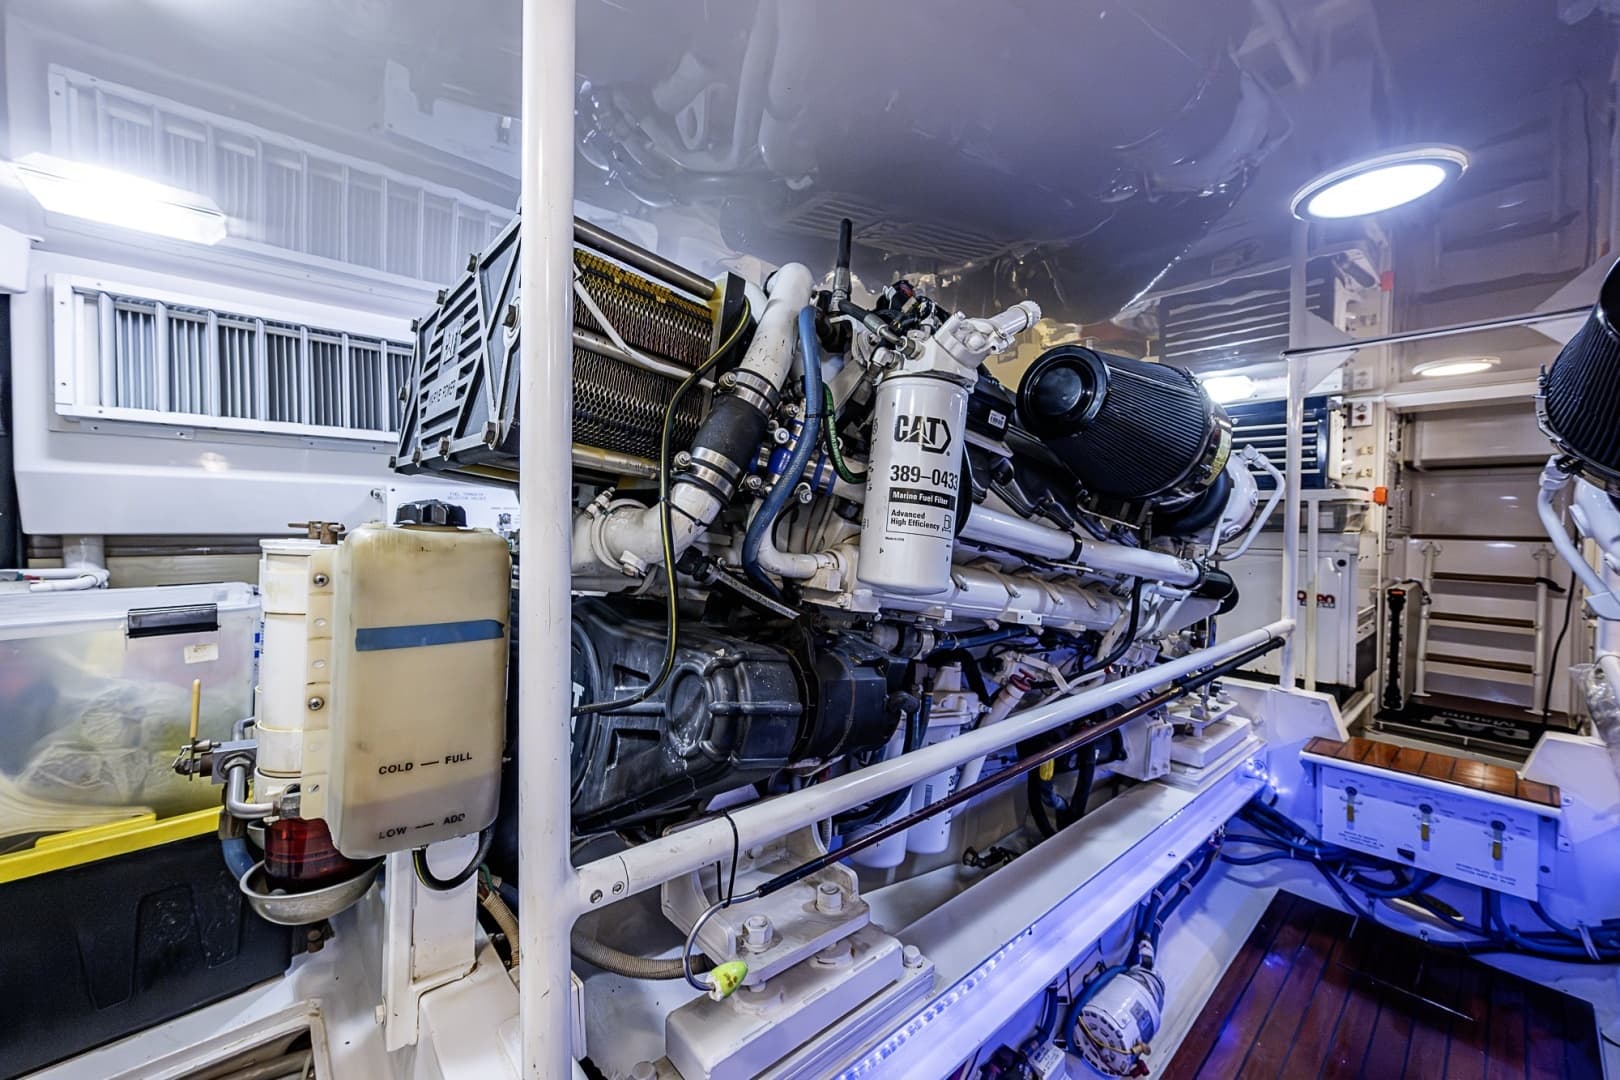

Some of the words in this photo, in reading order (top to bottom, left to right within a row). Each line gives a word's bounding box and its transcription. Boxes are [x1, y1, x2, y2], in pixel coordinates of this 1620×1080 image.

[894, 415, 941, 446] CAT
[890, 464, 958, 491] 389-0433
[892, 490, 918, 501] Marine
[919, 493, 934, 503] Fuel
[934, 495, 949, 505] Filter
[891, 508, 926, 520] Advanced
[890, 517, 907, 527] High
[907, 519, 941, 532] Efficiency
[378, 762, 414, 775] COLD
[444, 752, 473, 765] FULL
[378, 826, 408, 840] LOW
